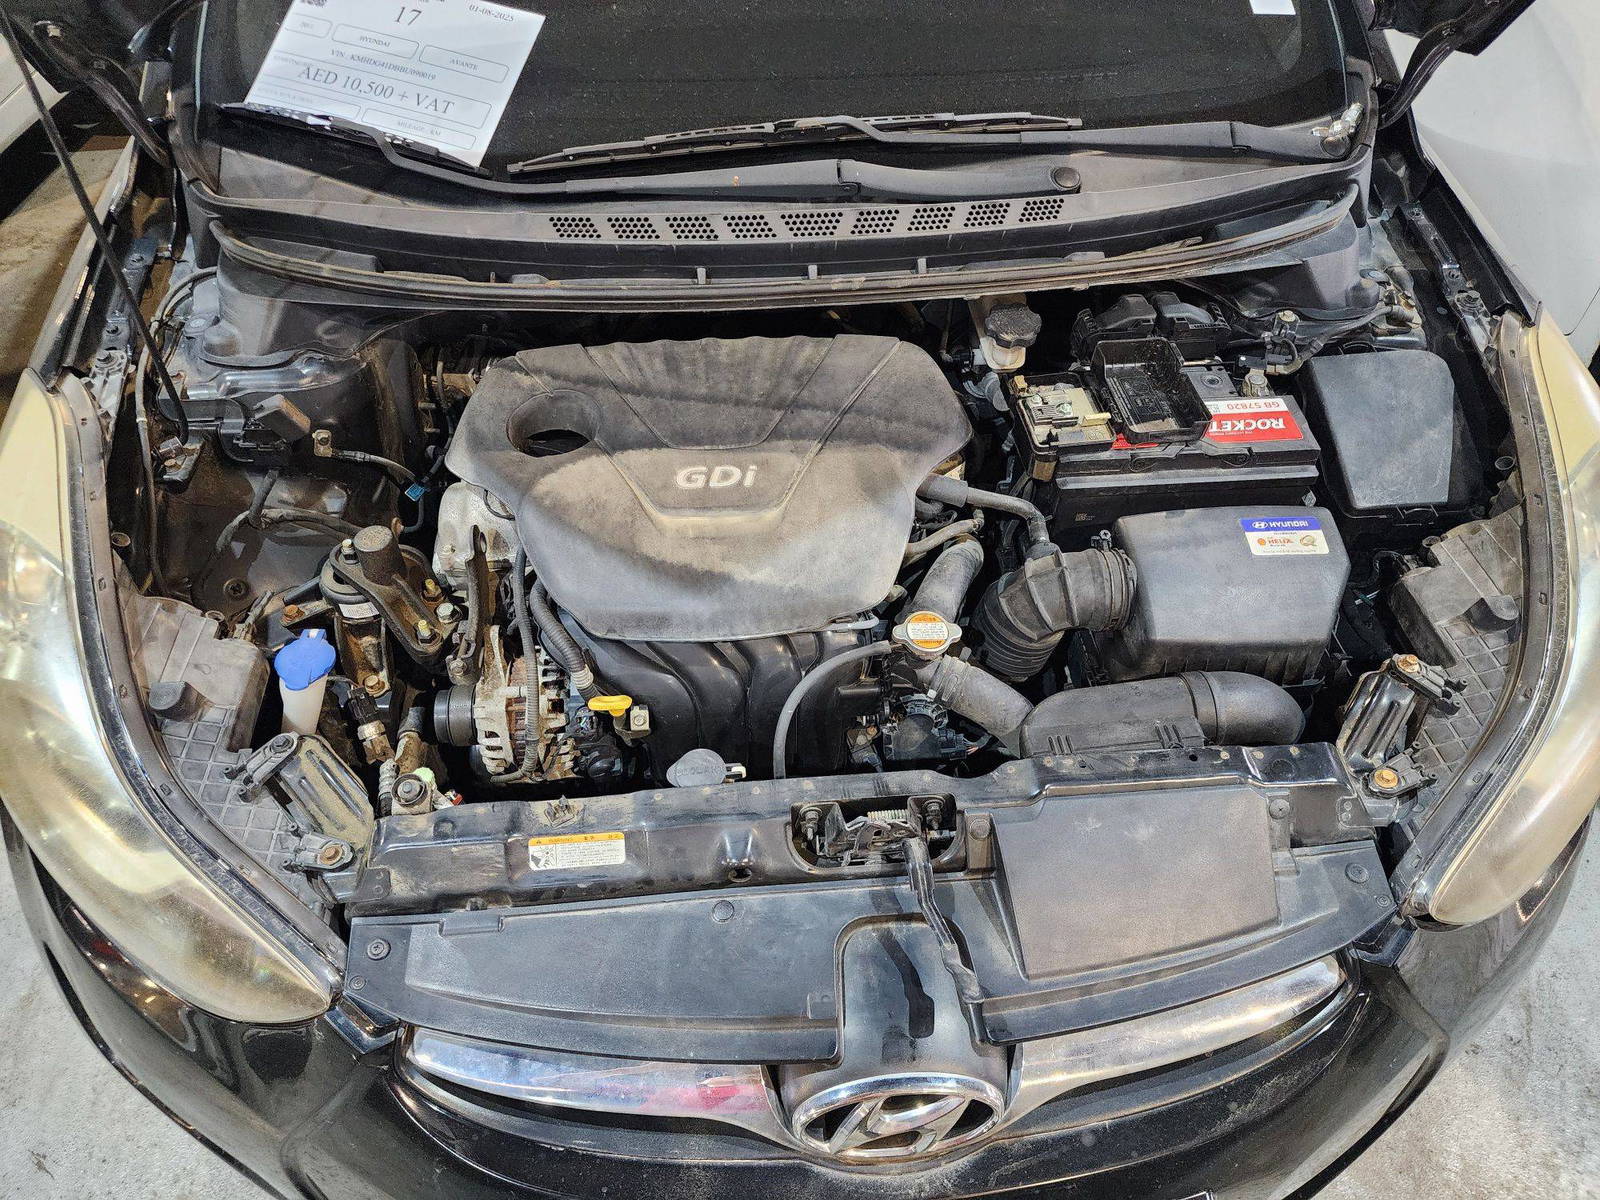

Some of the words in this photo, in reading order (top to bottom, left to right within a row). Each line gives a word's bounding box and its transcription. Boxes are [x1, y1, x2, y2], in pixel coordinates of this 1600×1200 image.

[393, 6, 422, 26] 17
[468, 4, 515, 22] 01-08-2025
[359, 34, 391, 48] HYUNDAI
[297, 65, 338, 85] AED
[398, 90, 409, 102] +
[416, 92, 456, 114] VAT
[1208, 417, 1287, 432] ROCKET
[675, 464, 758, 489] GDi
[1269, 520, 1309, 528] HYUNDAI
